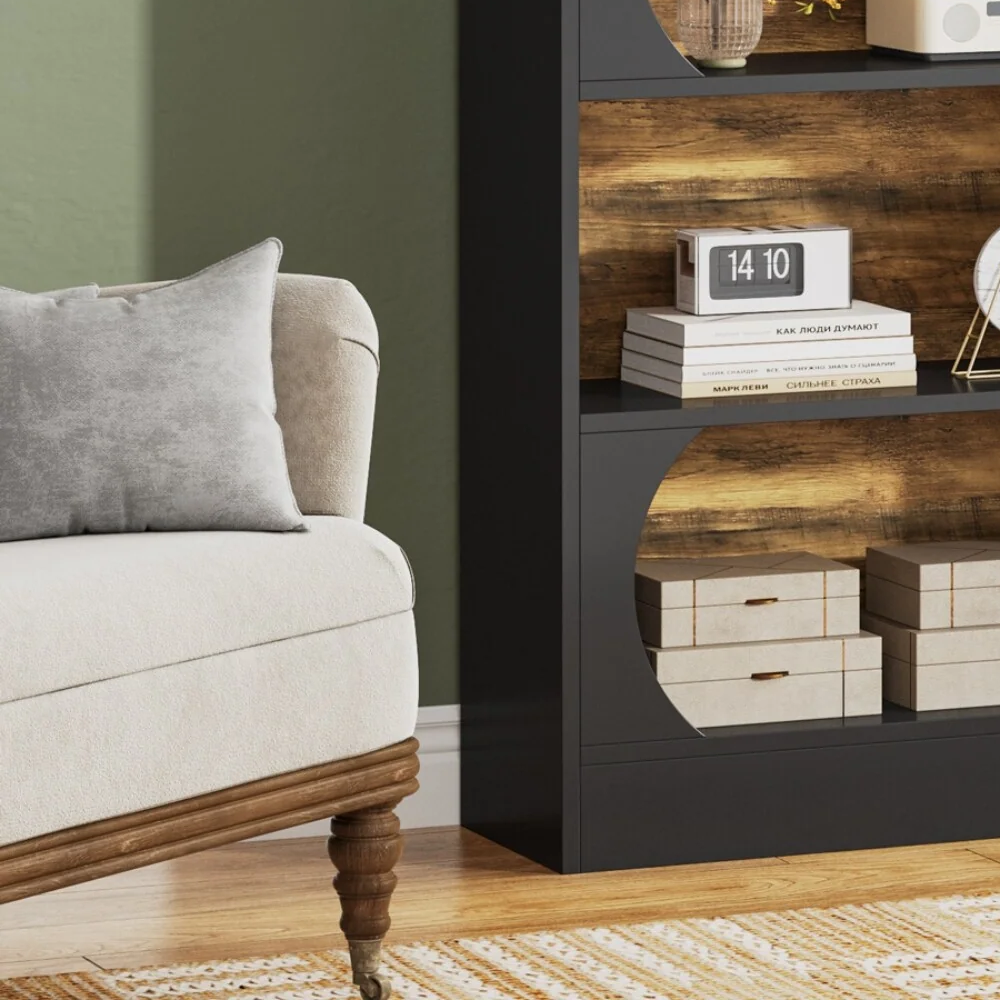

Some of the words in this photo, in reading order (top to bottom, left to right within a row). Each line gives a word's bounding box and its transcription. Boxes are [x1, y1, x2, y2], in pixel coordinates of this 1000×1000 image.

[728, 248, 755, 281] 14
[763, 248, 790, 279] 10
[799, 326, 830, 334] ЛЮДИ
[833, 323, 879, 333] ДУМАЮТ
[786, 380, 837, 389] СИЛЬНЕЕ
[842, 377, 881, 386] СТРАХА
